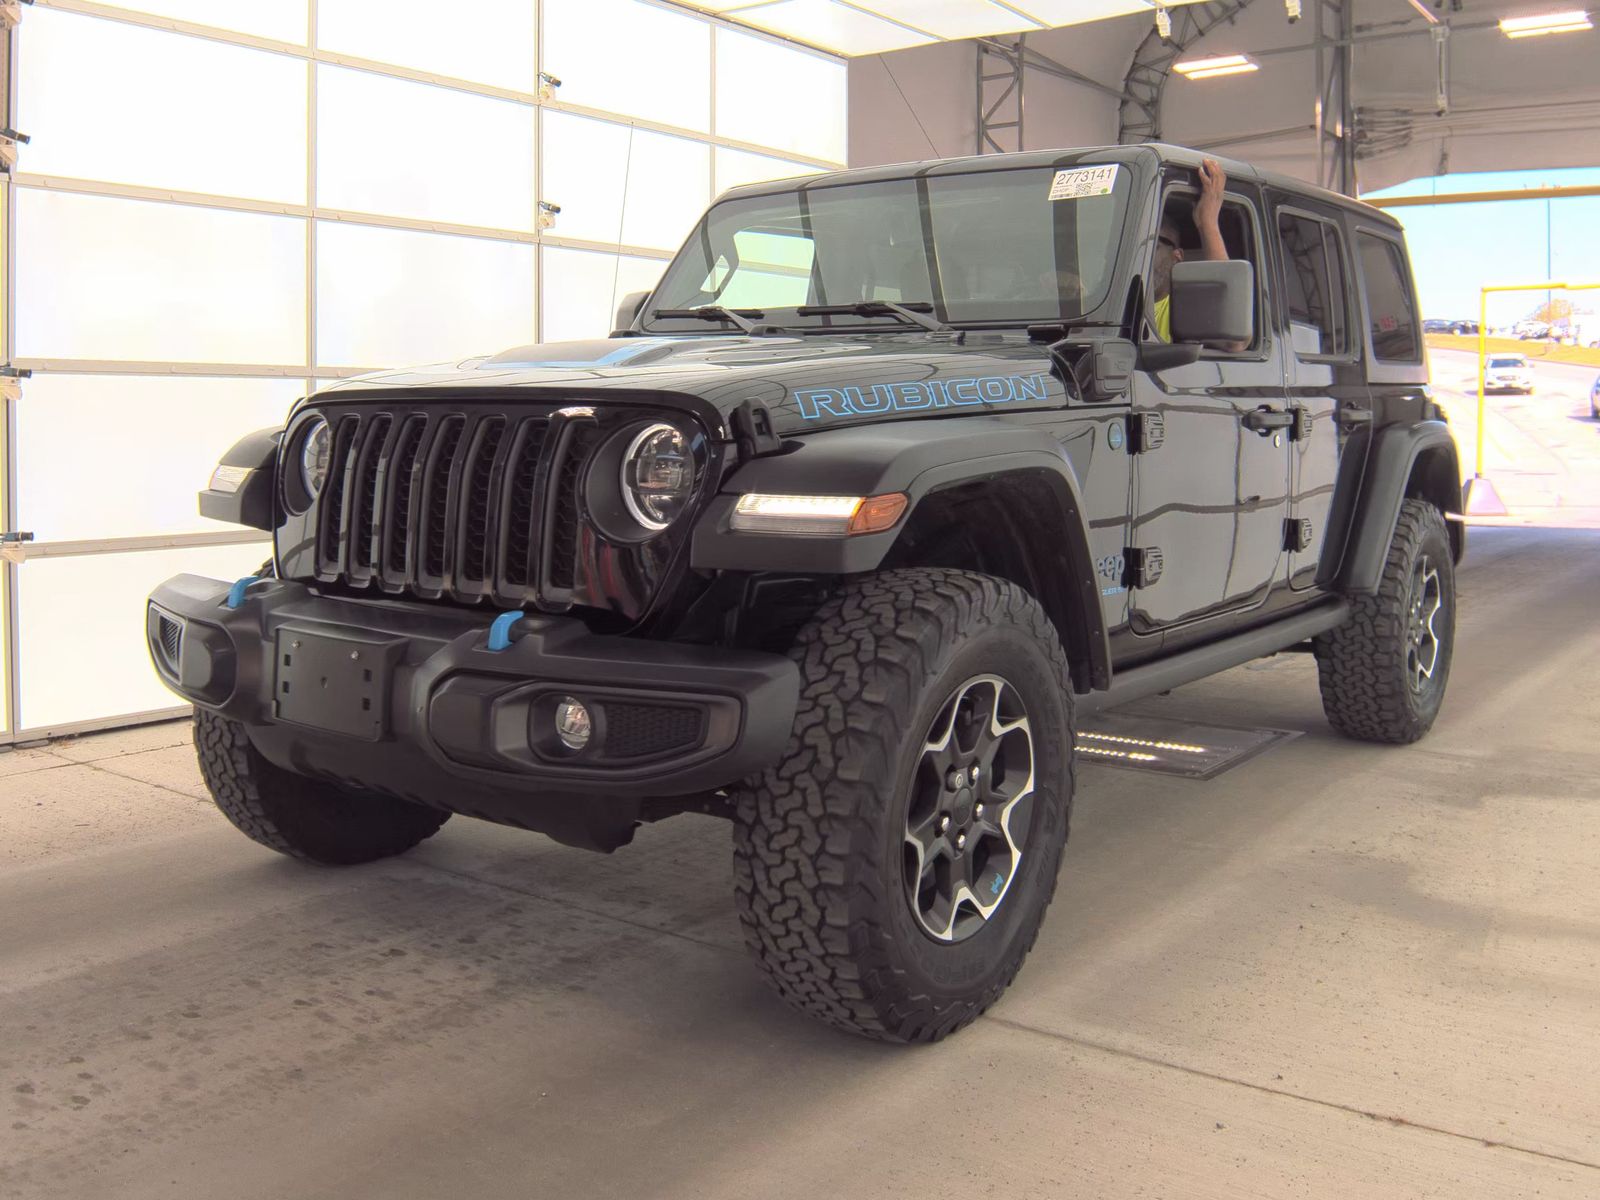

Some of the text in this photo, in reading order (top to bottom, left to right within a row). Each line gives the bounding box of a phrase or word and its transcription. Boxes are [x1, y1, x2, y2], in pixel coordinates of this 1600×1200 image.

[1056, 168, 1113, 185] 2773141
[794, 375, 1048, 419] RUBICON
[1095, 554, 1125, 581] eep
